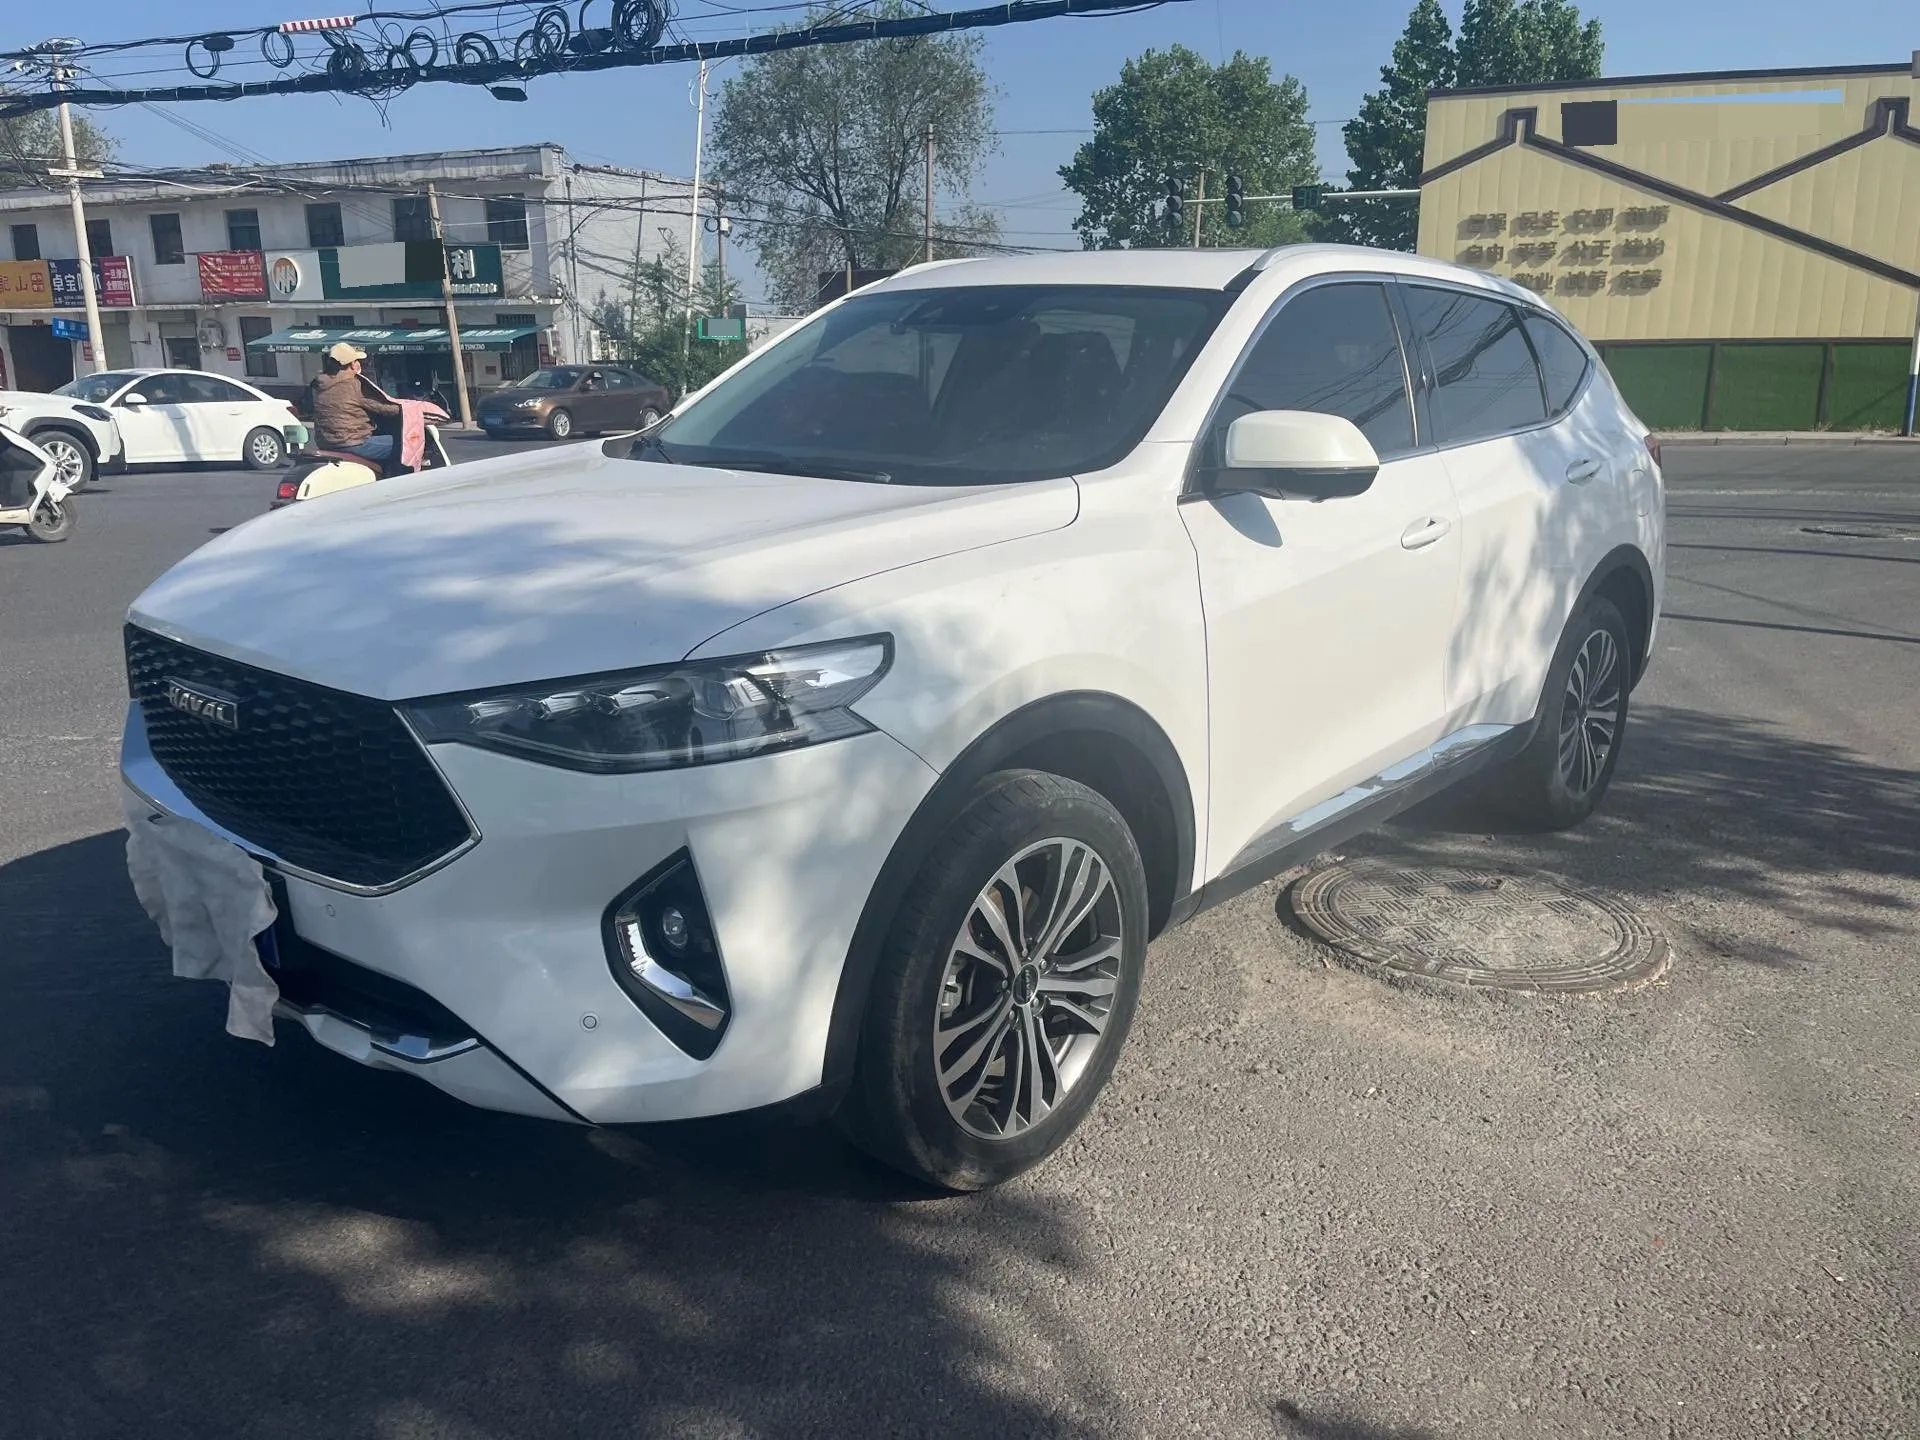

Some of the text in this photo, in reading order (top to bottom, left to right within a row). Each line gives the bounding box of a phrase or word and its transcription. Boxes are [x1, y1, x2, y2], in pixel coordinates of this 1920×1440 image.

[1518, 210, 1560, 232] 民主
[1571, 207, 1614, 228] 文明
[1624, 204, 1670, 226] 和谐
[1464, 243, 1504, 263] 自由
[1515, 241, 1558, 260] 平等
[1568, 239, 1611, 258] 公正
[1619, 268, 1663, 290] 友善
[169, 686, 232, 723] HAVAL
